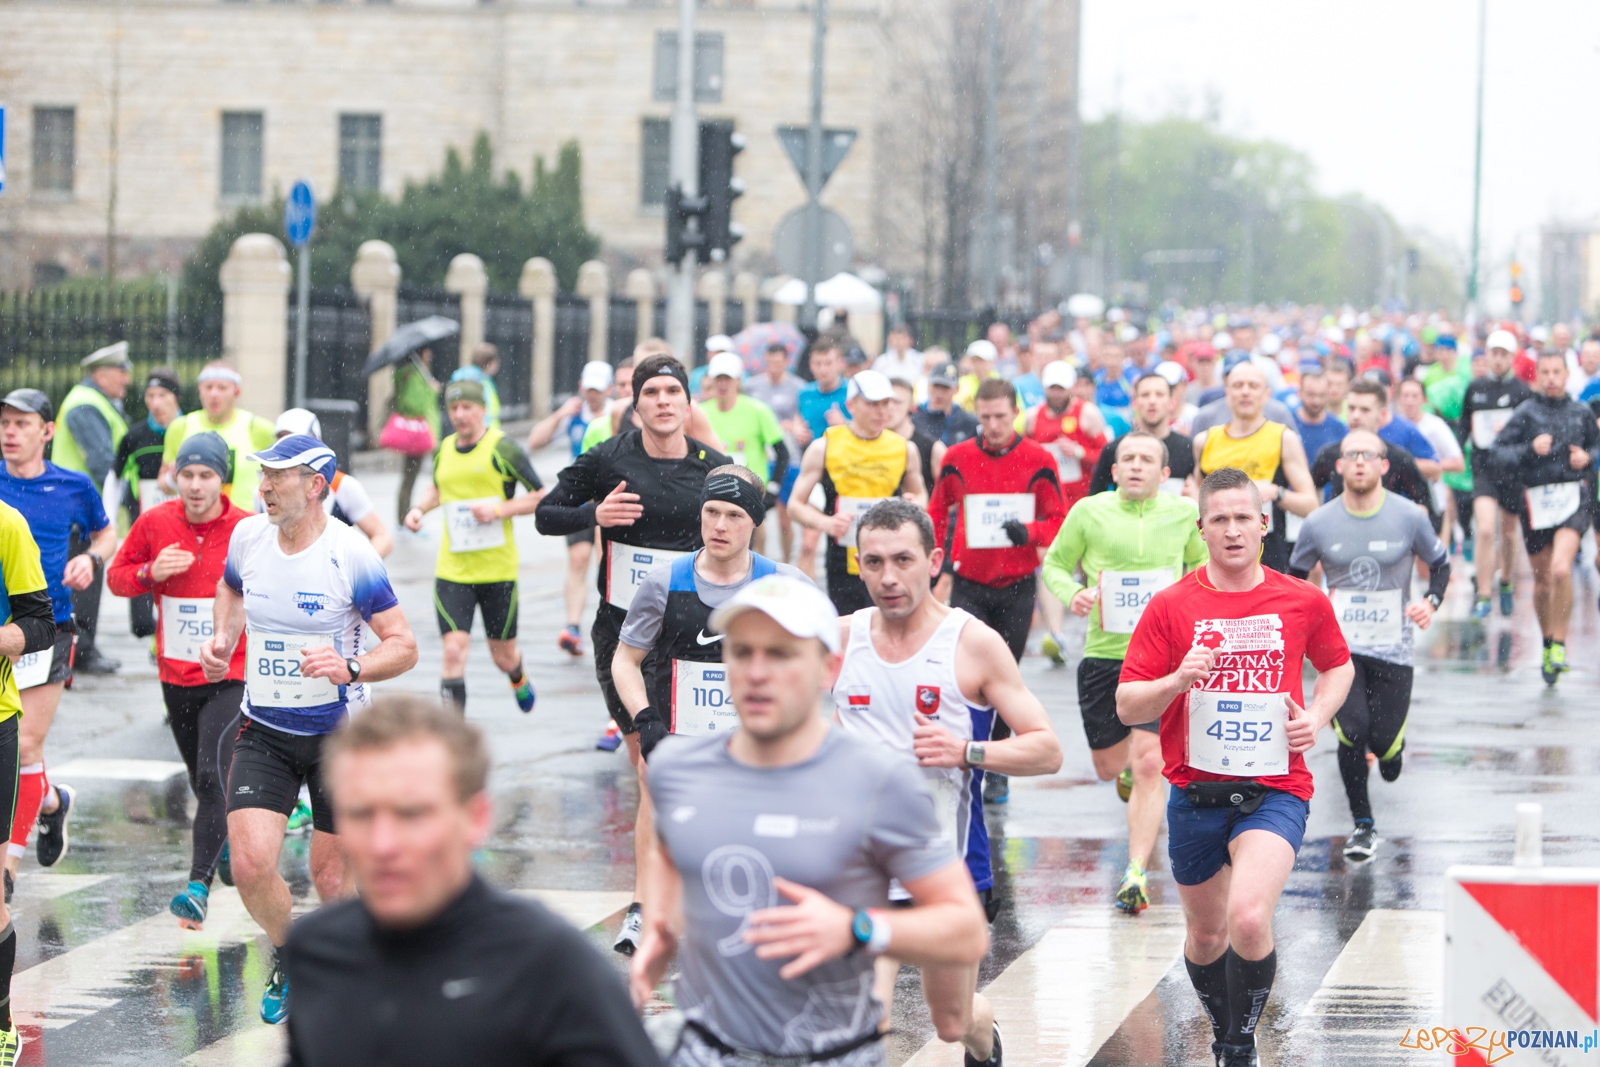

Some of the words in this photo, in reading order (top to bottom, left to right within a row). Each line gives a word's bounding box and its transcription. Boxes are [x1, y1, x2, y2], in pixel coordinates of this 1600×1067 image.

[292, 592, 331, 604] SANPOL
[1343, 608, 1390, 622] 6842
[176, 618, 213, 636] 756
[1225, 618, 1271, 627] MISTRZOSTWA
[1252, 624, 1275, 632] SZPIKU
[1236, 631, 1272, 640] MARATONIE
[1213, 651, 1270, 669] UŻYNA
[258, 657, 311, 677] 862
[712, 709, 739, 717] Tomasz
[1206, 720, 1273, 742] 4352
[1223, 743, 1257, 752] Krzysztof
